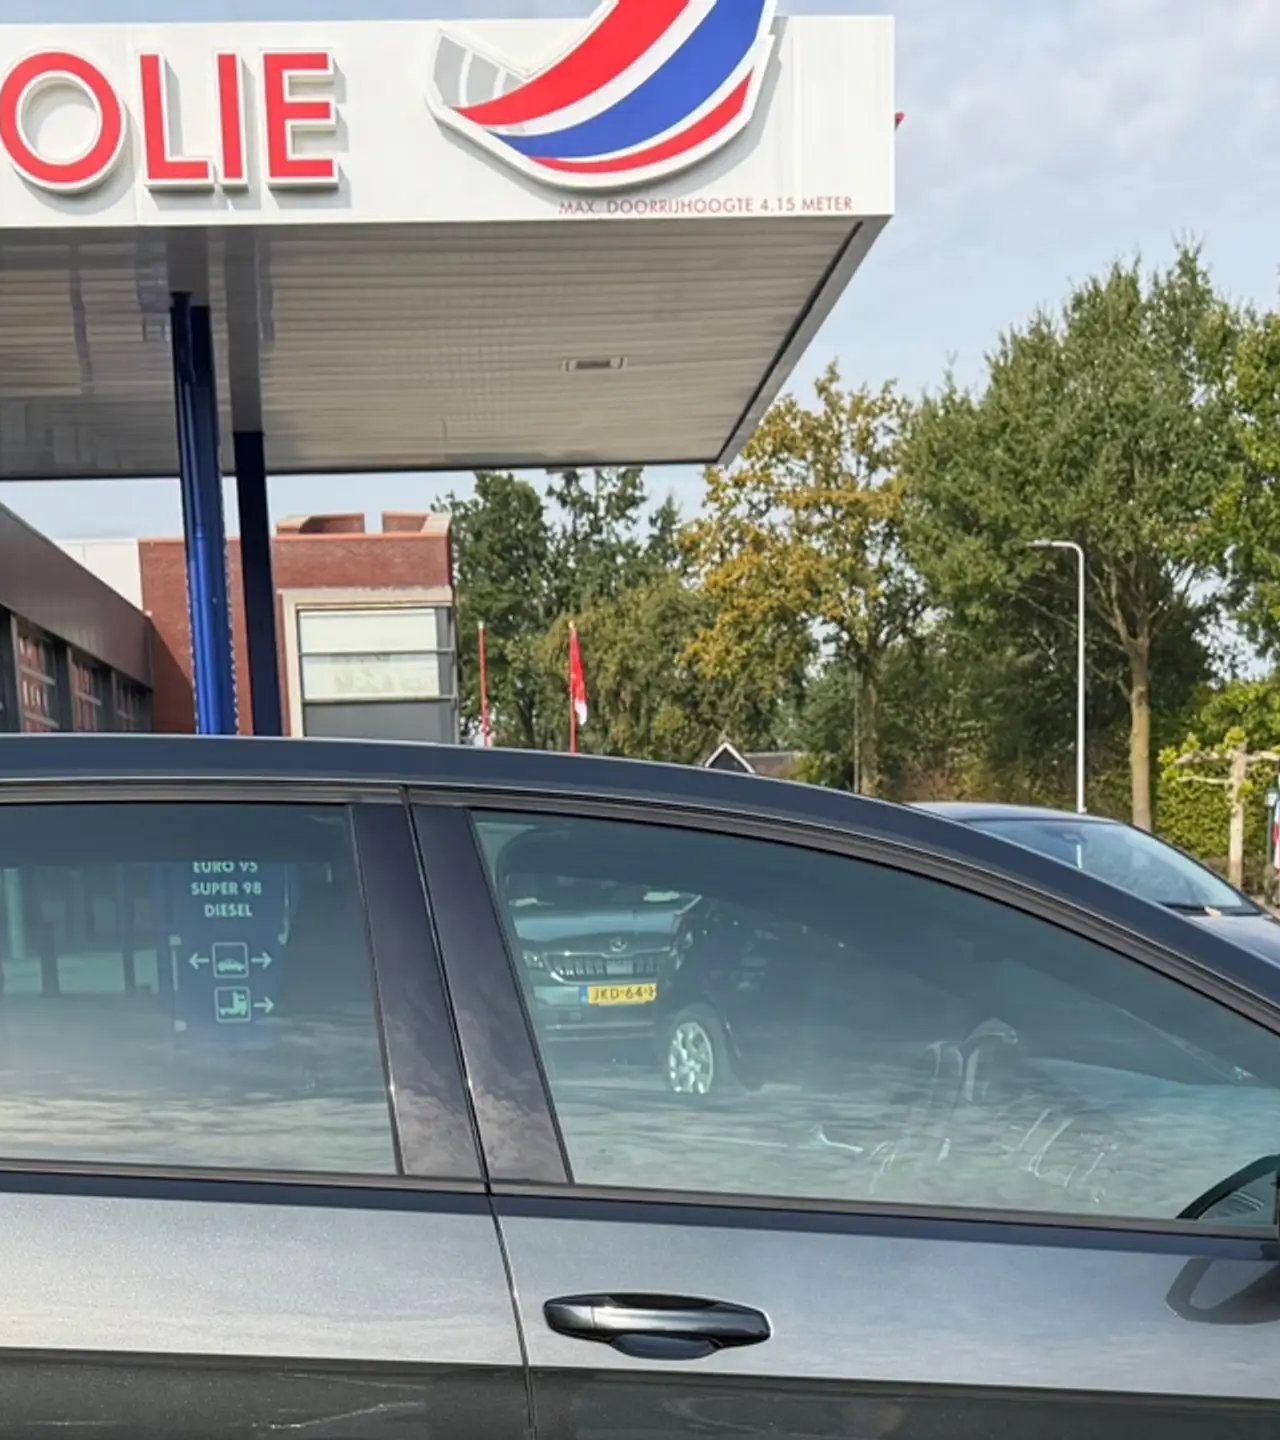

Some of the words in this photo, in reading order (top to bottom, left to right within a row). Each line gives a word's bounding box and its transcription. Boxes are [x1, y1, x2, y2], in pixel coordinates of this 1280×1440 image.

[606, 199, 753, 215] DOORRIJHOOGTE
[760, 198, 796, 212] 4.15
[801, 196, 853, 211] METER
[191, 881, 239, 895] SUPER
[243, 881, 262, 895] 98
[204, 904, 253, 918] DIESEL
